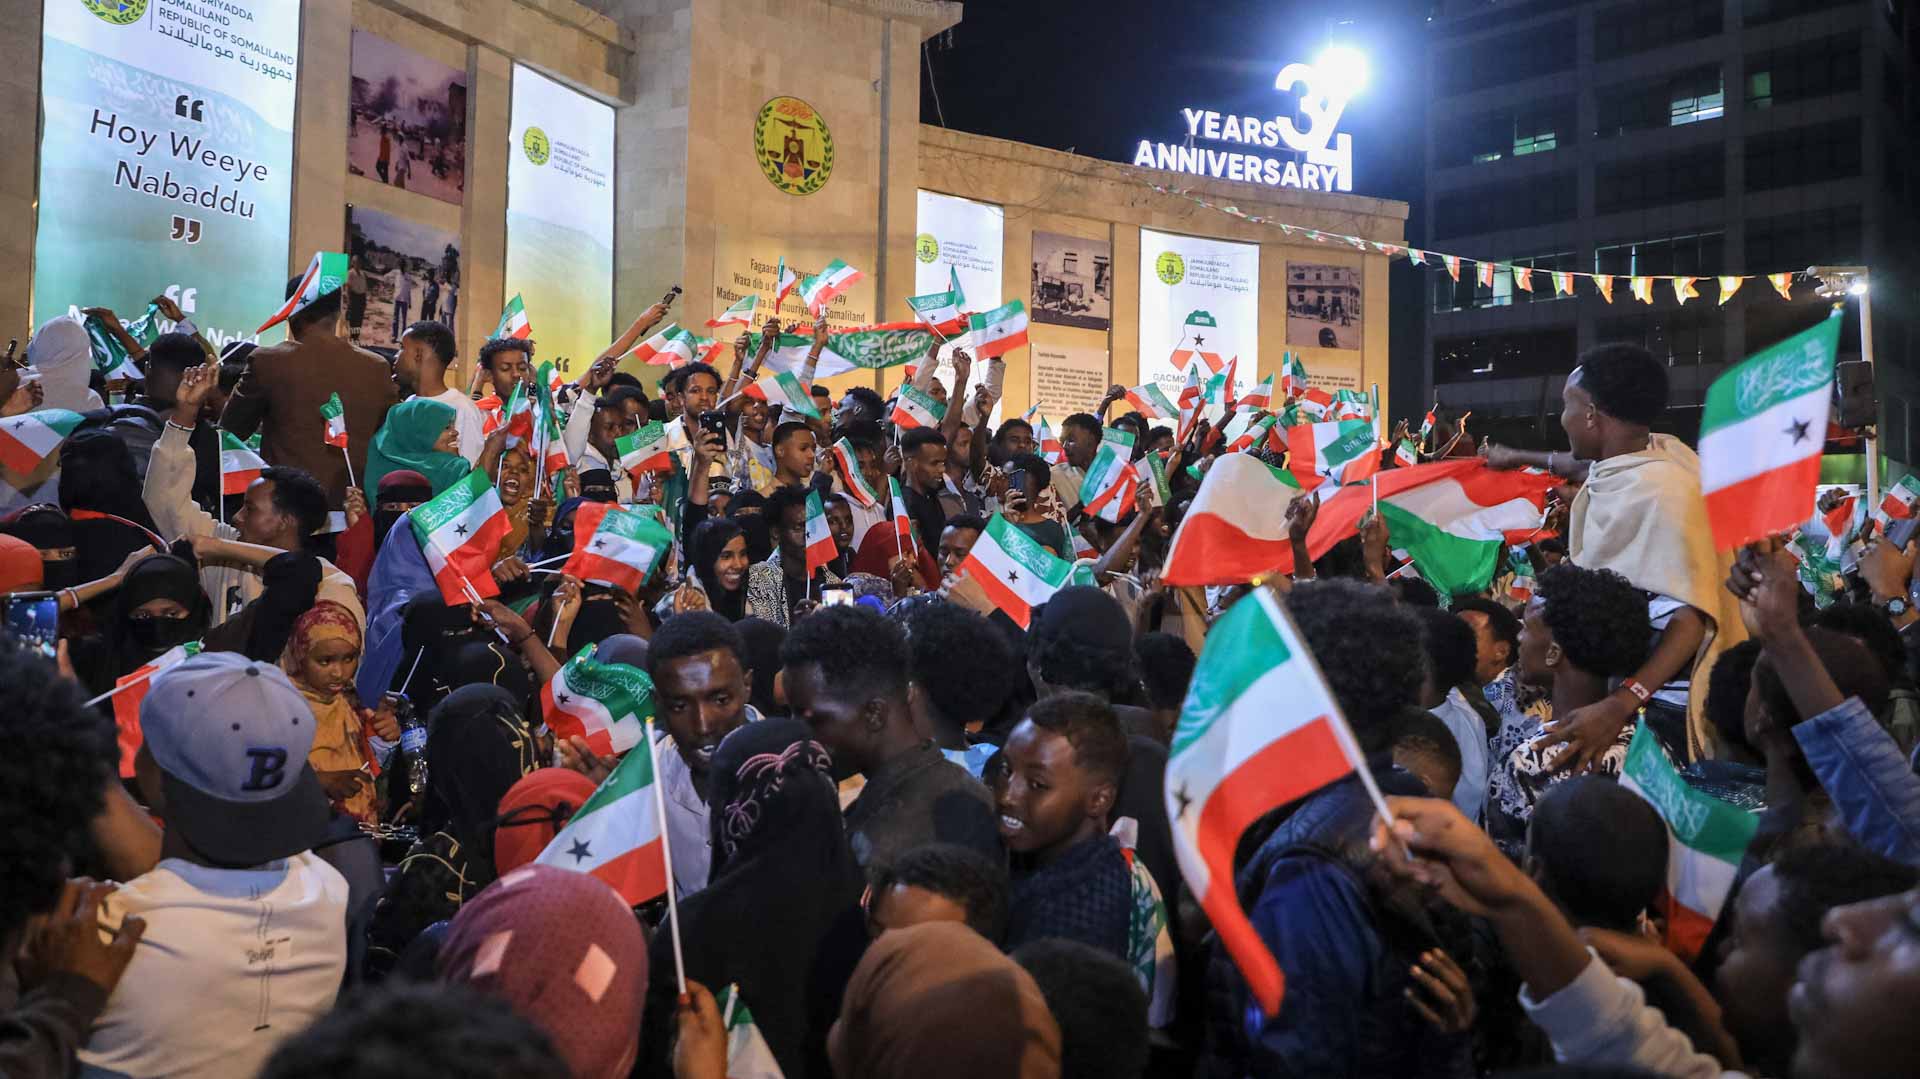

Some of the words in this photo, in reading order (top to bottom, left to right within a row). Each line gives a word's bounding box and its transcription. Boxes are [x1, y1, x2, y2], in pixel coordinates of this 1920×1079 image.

[160, 0, 230, 26] OMALILAND
[159, 8, 211, 34] REPUBLIC
[213, 28, 229, 41] OF
[230, 34, 295, 66] SOMALILAND
[239, 52, 293, 81] جمهورية
[90, 108, 158, 156] Hoy
[169, 131, 269, 183] Weeye
[1183, 107, 1279, 148] YEARS
[1133, 139, 1339, 192] ANNIVERSARY
[114, 160, 255, 219] Nabaddu
[733, 271, 751, 287] Waxa
[752, 277, 764, 290] dib
[825, 306, 866, 323] Somaliland
[241, 745, 288, 792] B
